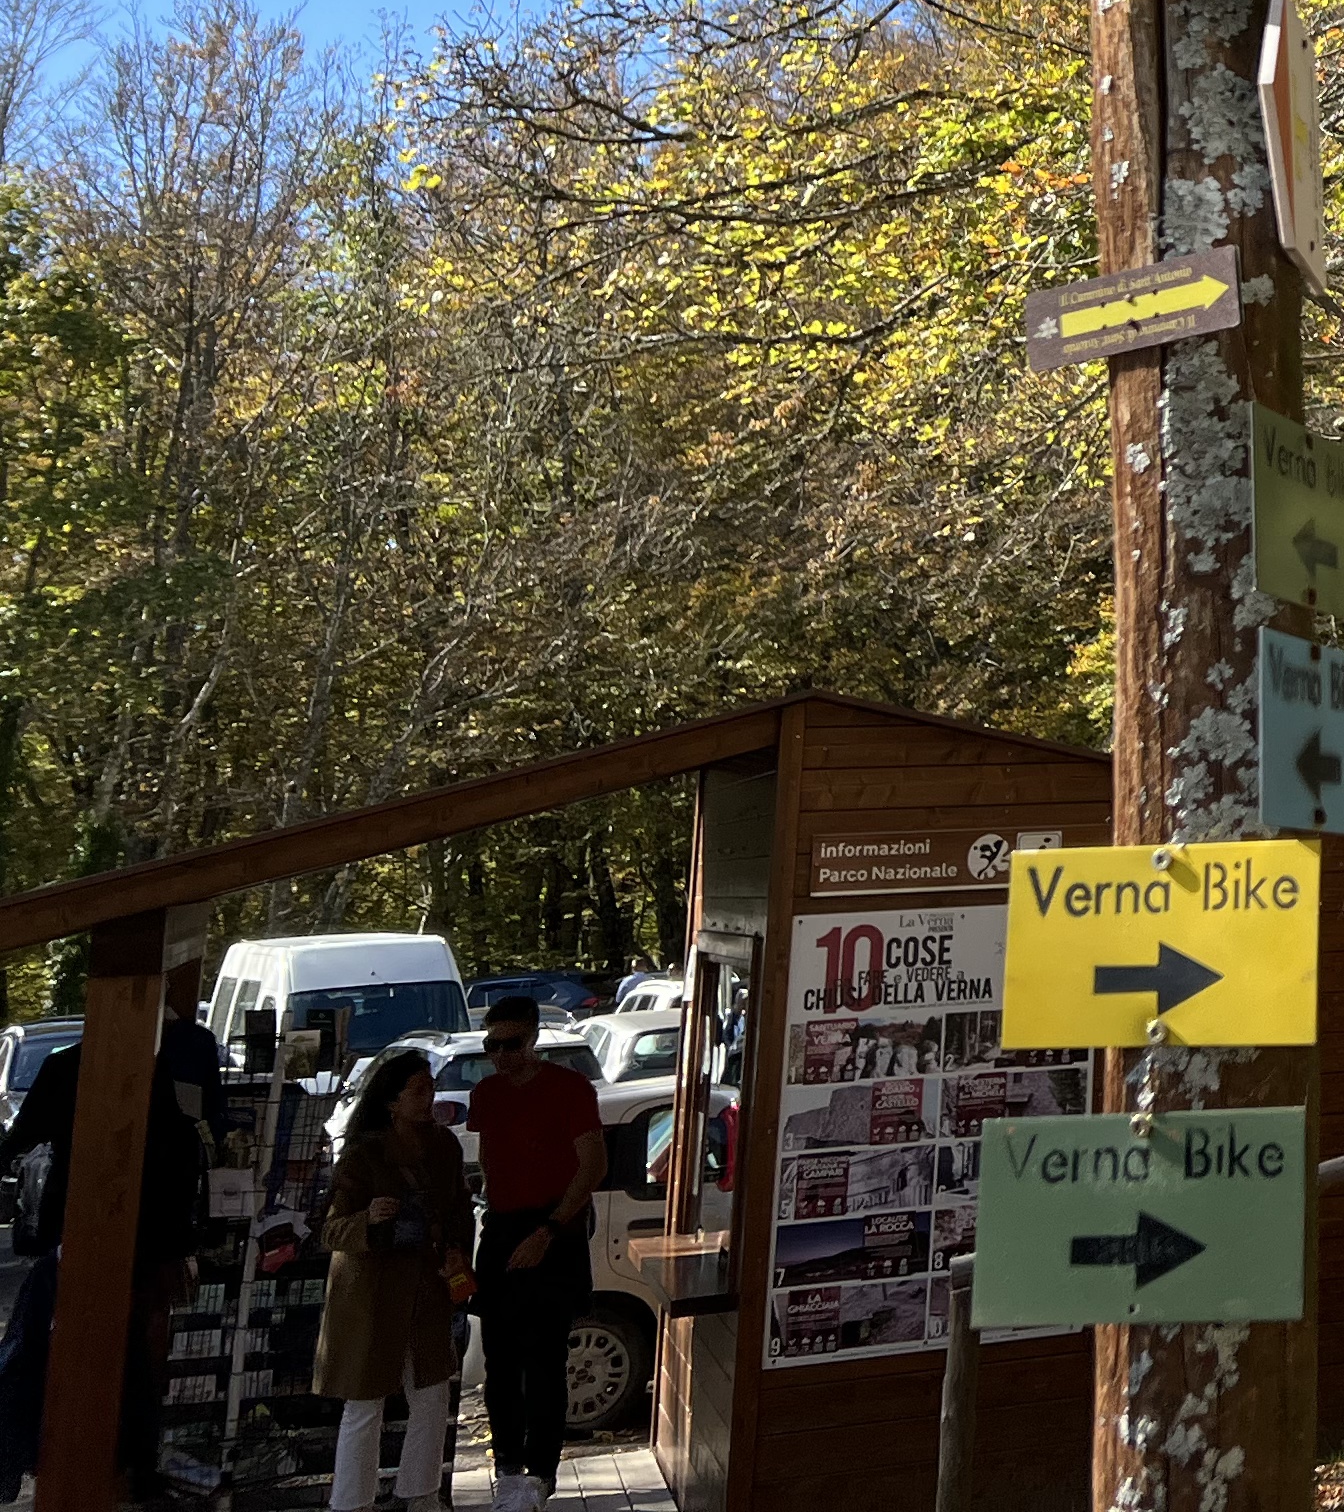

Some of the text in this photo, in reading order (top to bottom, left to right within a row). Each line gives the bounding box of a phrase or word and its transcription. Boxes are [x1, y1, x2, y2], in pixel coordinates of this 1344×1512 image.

[1262, 424, 1317, 490] Verna
[1269, 641, 1323, 708] Verna
[820, 838, 932, 859] informazioni
[819, 863, 959, 884] Parco Nazionale
[1027, 856, 1301, 918] Verna Bike
[899, 913, 954, 928] La Verna
[816, 923, 954, 1015] 10 COSE
[858, 969, 890, 986] FARE
[906, 967, 952, 983] VEDERE
[873, 981, 926, 1006] DELLA
[934, 977, 993, 1002] VERNA
[1006, 1124, 1287, 1186] Verna Bike
[879, 1221, 915, 1233] ROCCA
[933, 1251, 945, 1270] 8
[774, 1268, 786, 1288] 7
[770, 1337, 781, 1356] 9
